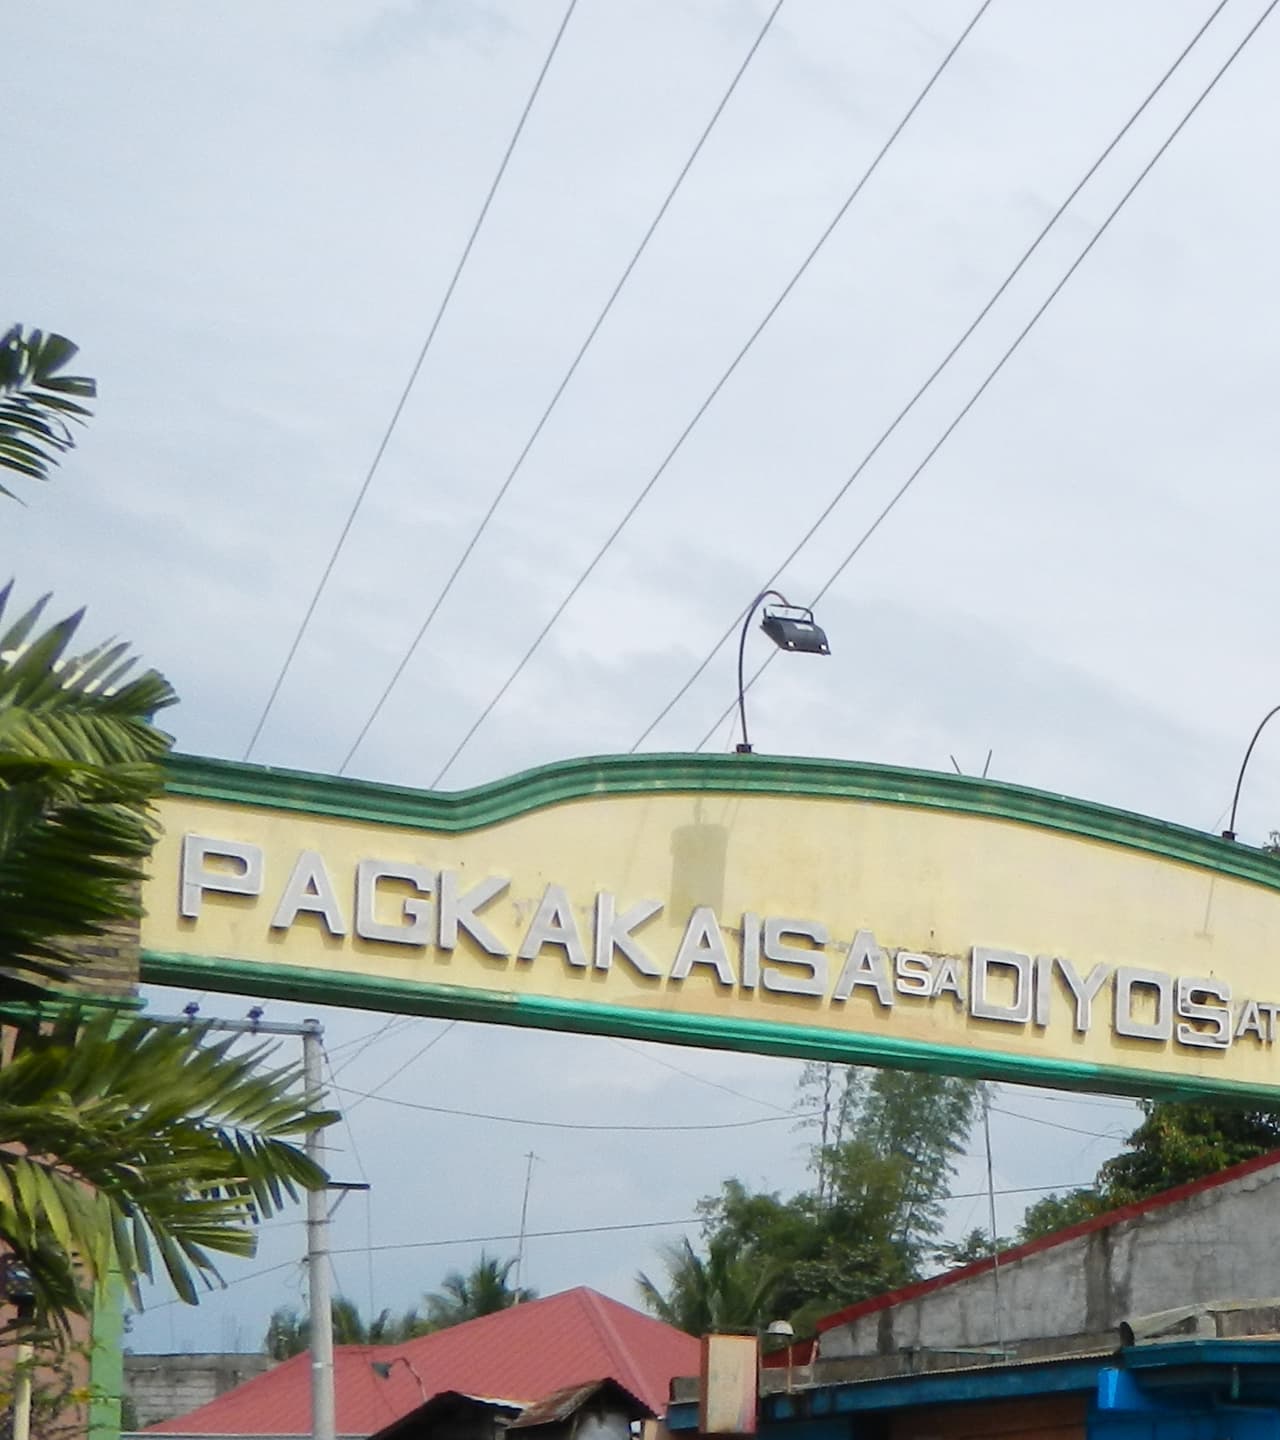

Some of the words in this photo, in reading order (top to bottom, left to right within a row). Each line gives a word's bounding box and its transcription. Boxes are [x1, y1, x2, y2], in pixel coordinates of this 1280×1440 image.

[179, 831, 893, 1007] PAGKAKAISA
[895, 950, 965, 1001] SA
[969, 945, 1233, 1050] DIYOS
